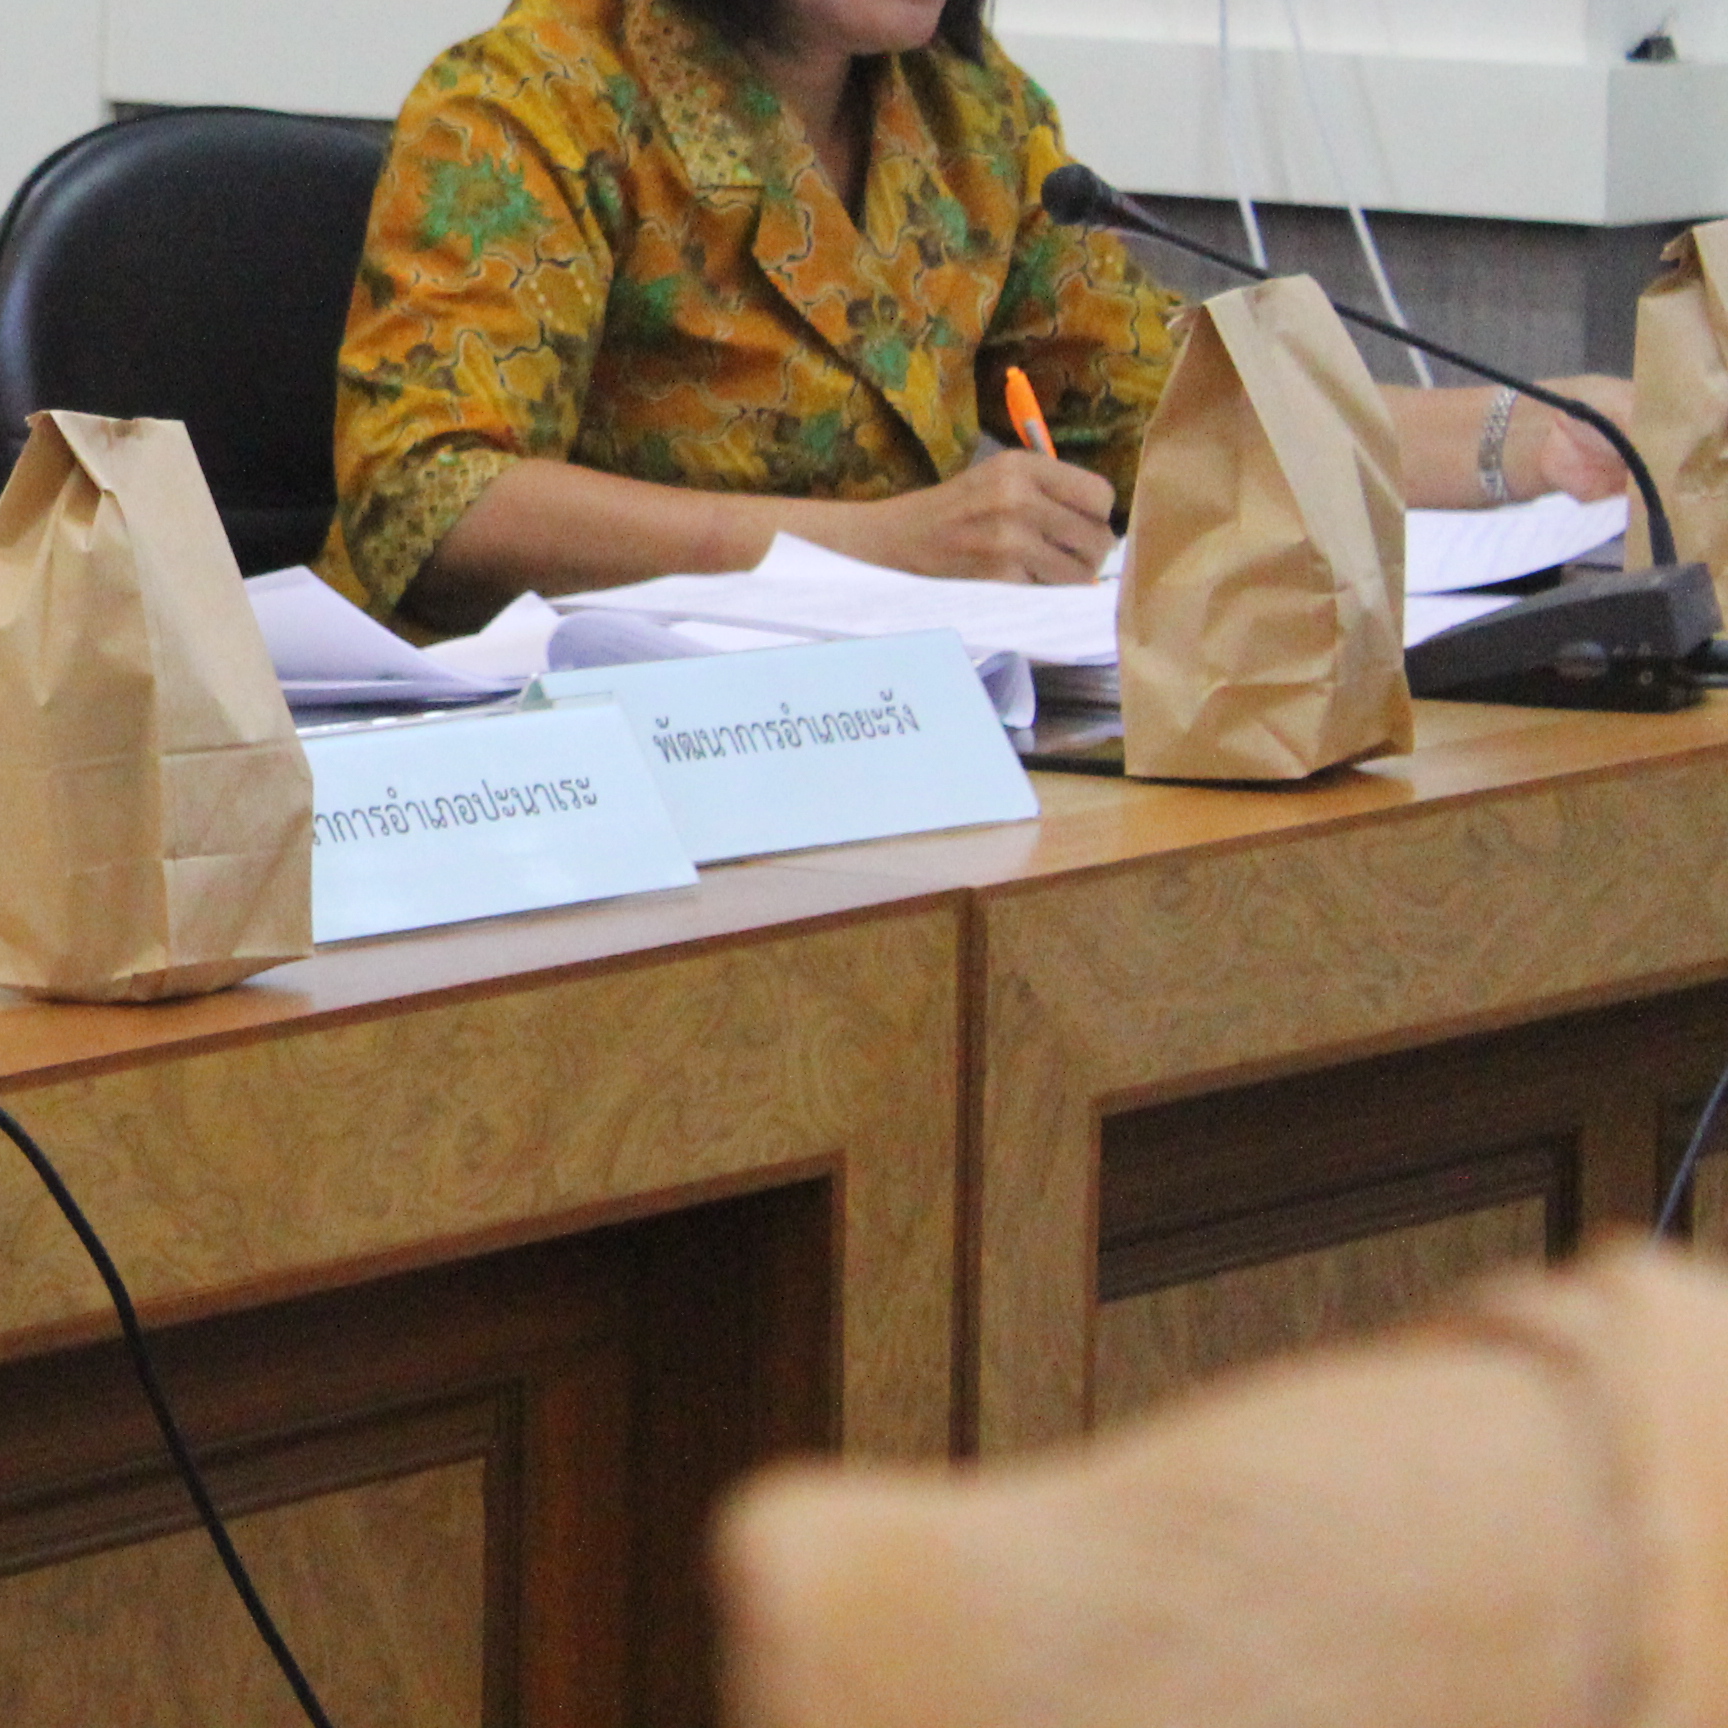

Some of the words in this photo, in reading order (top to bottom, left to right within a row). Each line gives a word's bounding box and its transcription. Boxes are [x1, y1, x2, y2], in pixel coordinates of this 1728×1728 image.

[652, 690, 920, 764] พัฒนาการอำเภอยะรัง
[313, 778, 598, 847] าการอำเภอปะนาเระ
